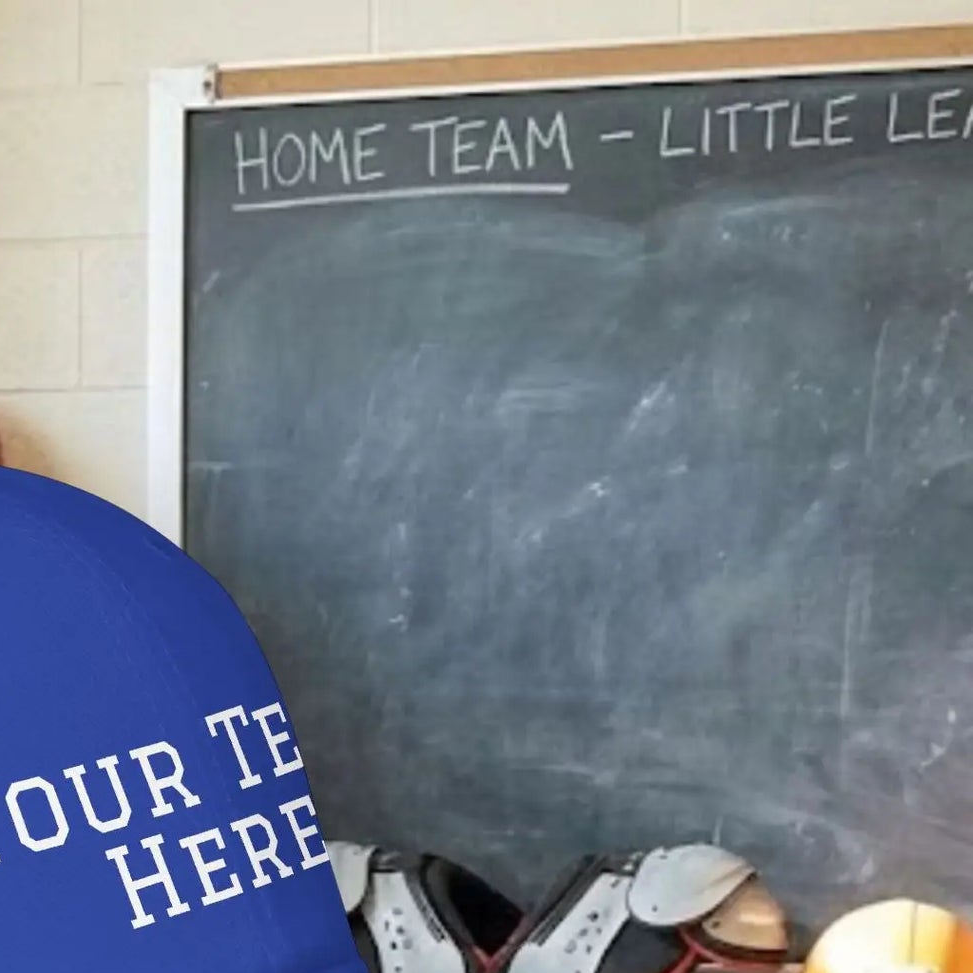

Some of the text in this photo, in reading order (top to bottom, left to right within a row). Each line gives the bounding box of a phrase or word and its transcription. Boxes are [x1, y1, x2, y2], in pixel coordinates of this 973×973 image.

[234, 123, 386, 195] HOME
[409, 111, 574, 178] TEAM
[659, 95, 856, 157] LITTLE
[105, 794, 330, 930] HERE
